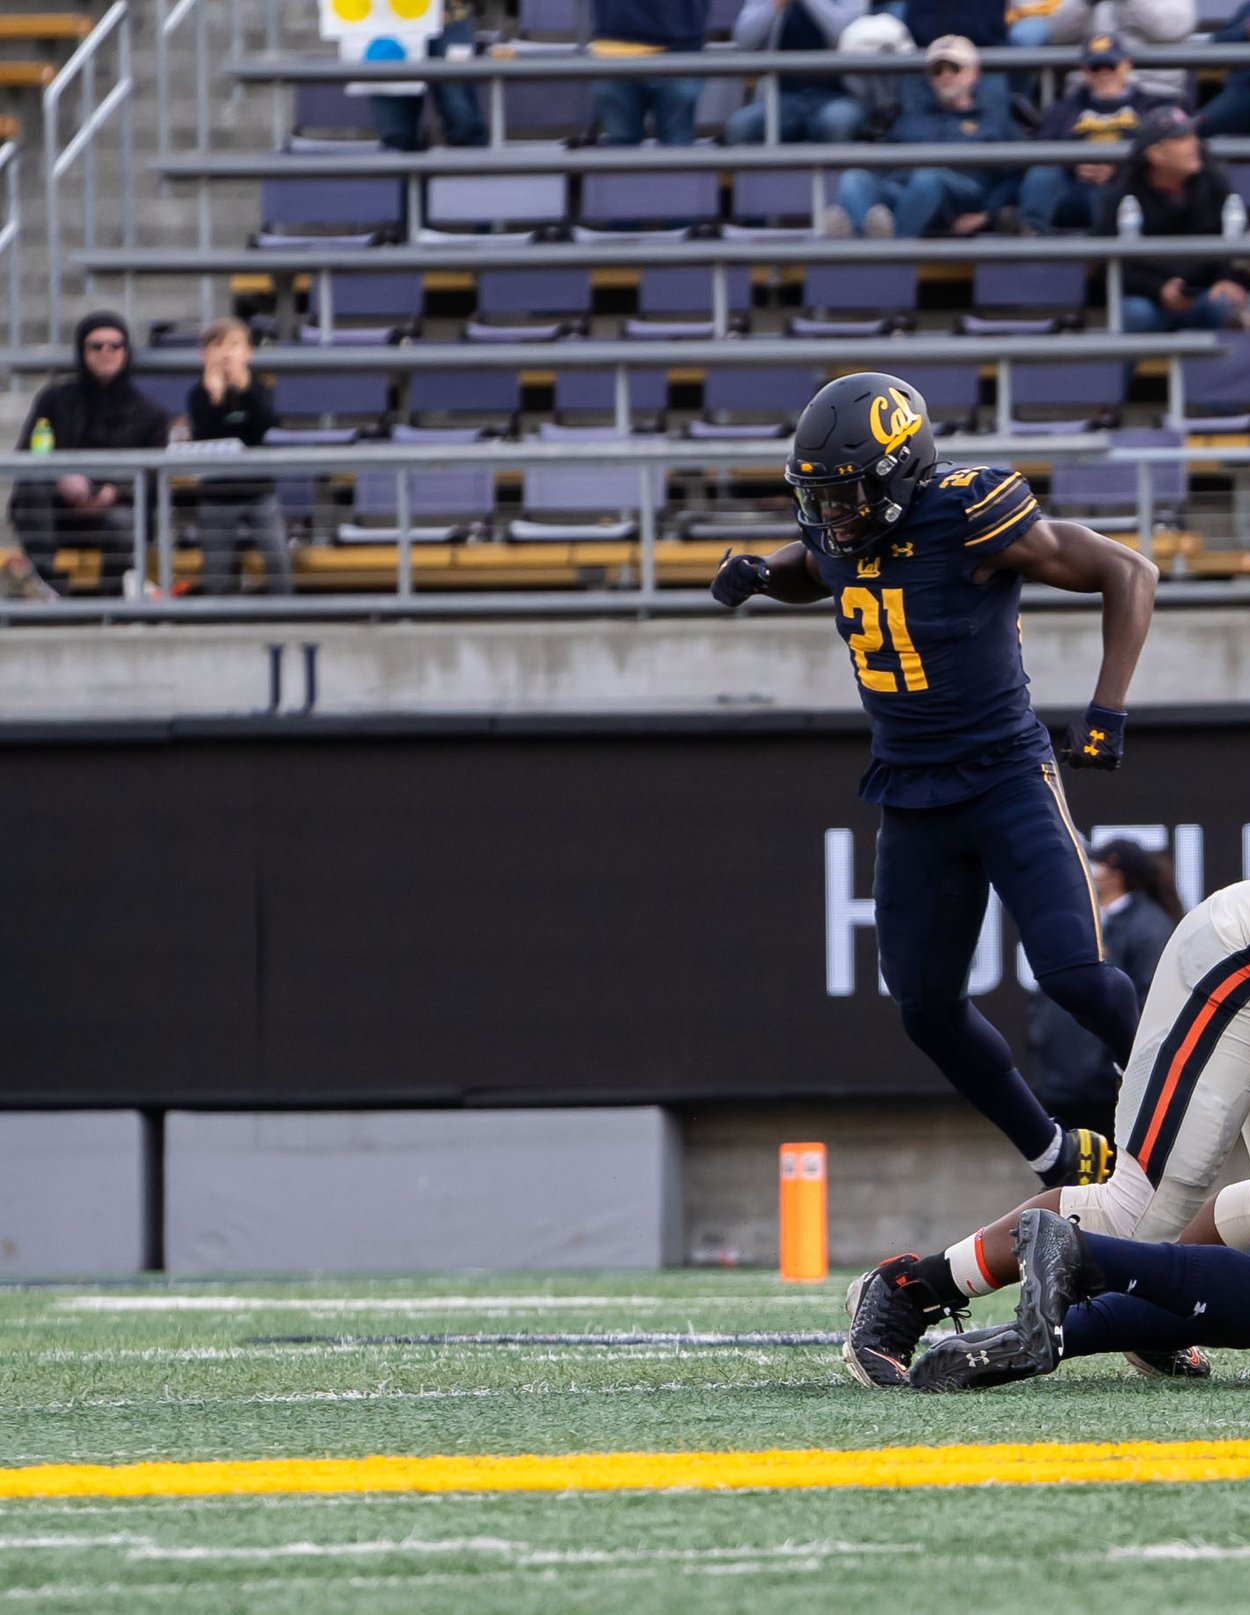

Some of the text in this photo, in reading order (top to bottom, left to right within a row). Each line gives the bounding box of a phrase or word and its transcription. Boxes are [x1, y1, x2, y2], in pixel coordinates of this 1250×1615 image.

[870, 387, 922, 454] Cal
[856, 557, 881, 578] Cal
[841, 586, 929, 692] 21
